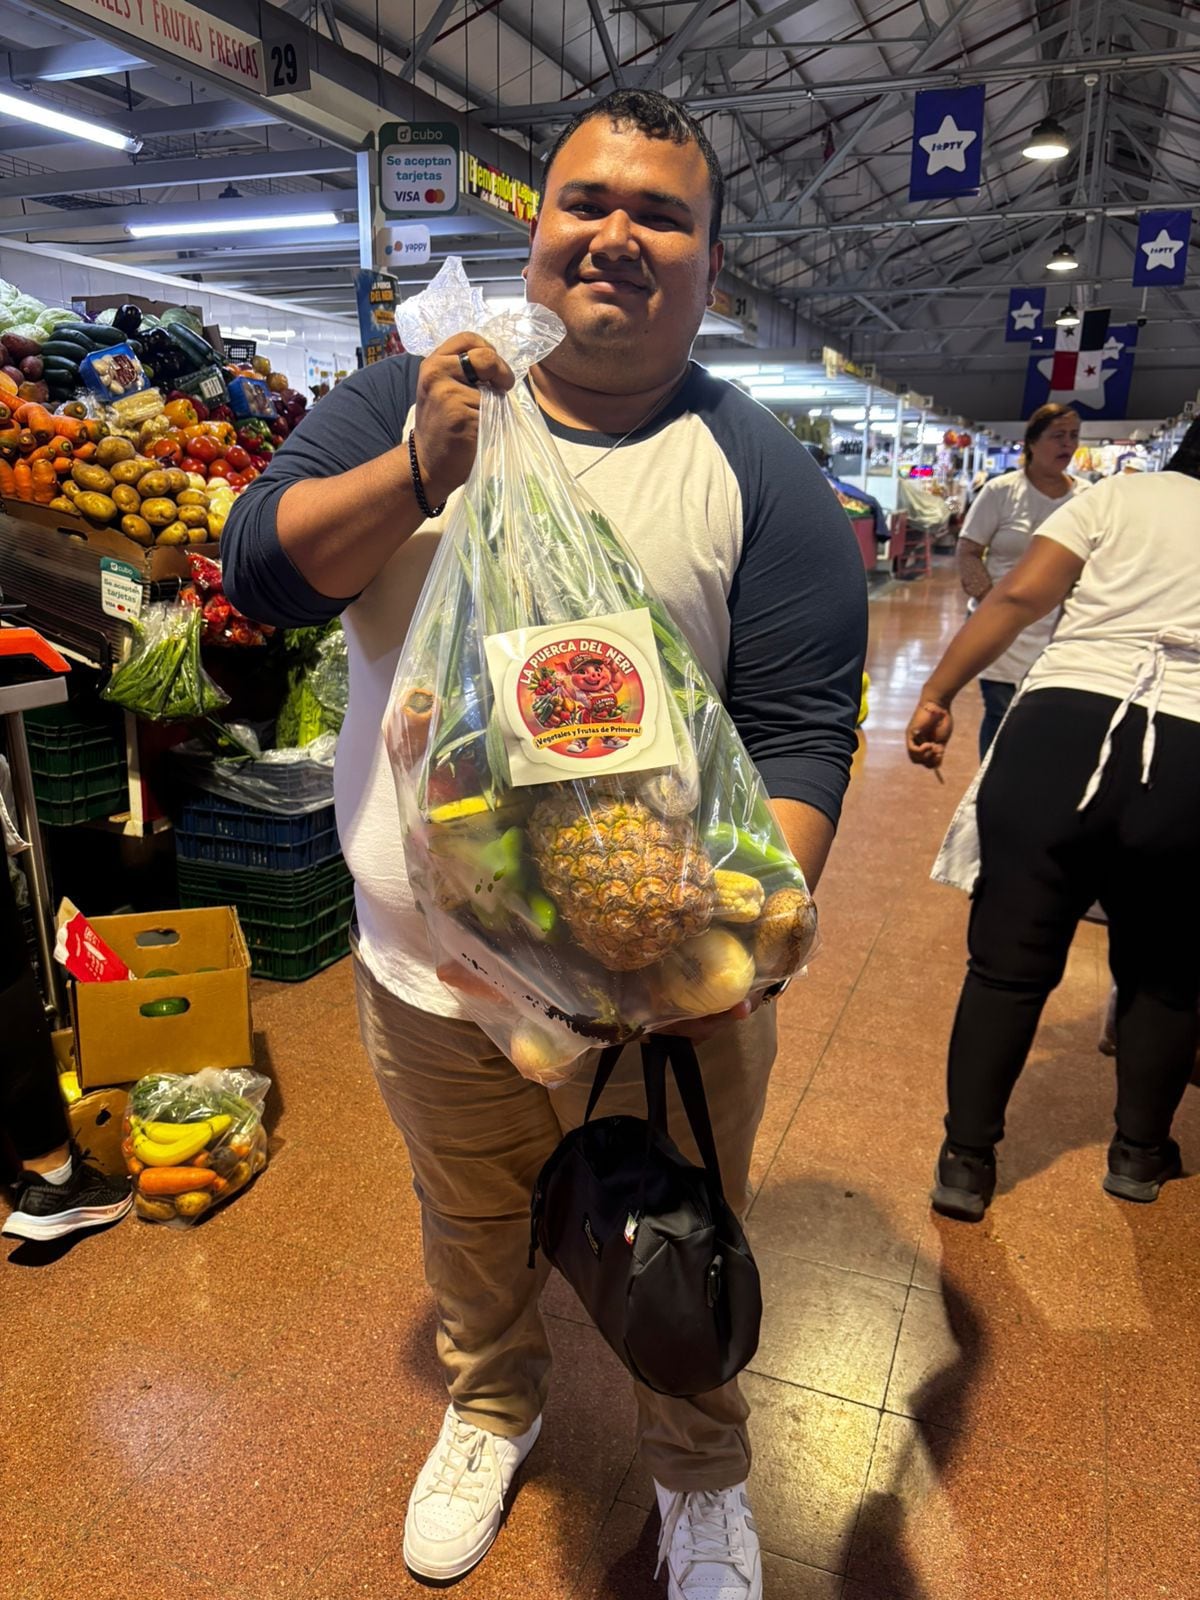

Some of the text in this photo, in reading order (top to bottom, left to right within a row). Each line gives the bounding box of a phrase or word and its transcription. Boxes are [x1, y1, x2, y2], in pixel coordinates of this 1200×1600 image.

[137, 0, 144, 26] Y
[153, 1, 203, 53] FRUTAS
[208, 27, 259, 80] FRESCAS
[271, 43, 298, 87] 29
[412, 129, 443, 140] cubo
[386, 155, 452, 168] Se aceptan
[396, 171, 442, 183] tarjetas
[393, 190, 421, 202] VISA
[405, 242, 427, 253] yappy
[735, 297, 747, 316] 31
[107, 588, 137, 604] tarjetas
[520, 669, 534, 684] LA
[529, 641, 576, 668] PUERCA
[580, 641, 602, 655] DEL
[605, 648, 634, 674] NERI
[577, 726, 599, 735] Frutas
[610, 726, 642, 734] Primera!
